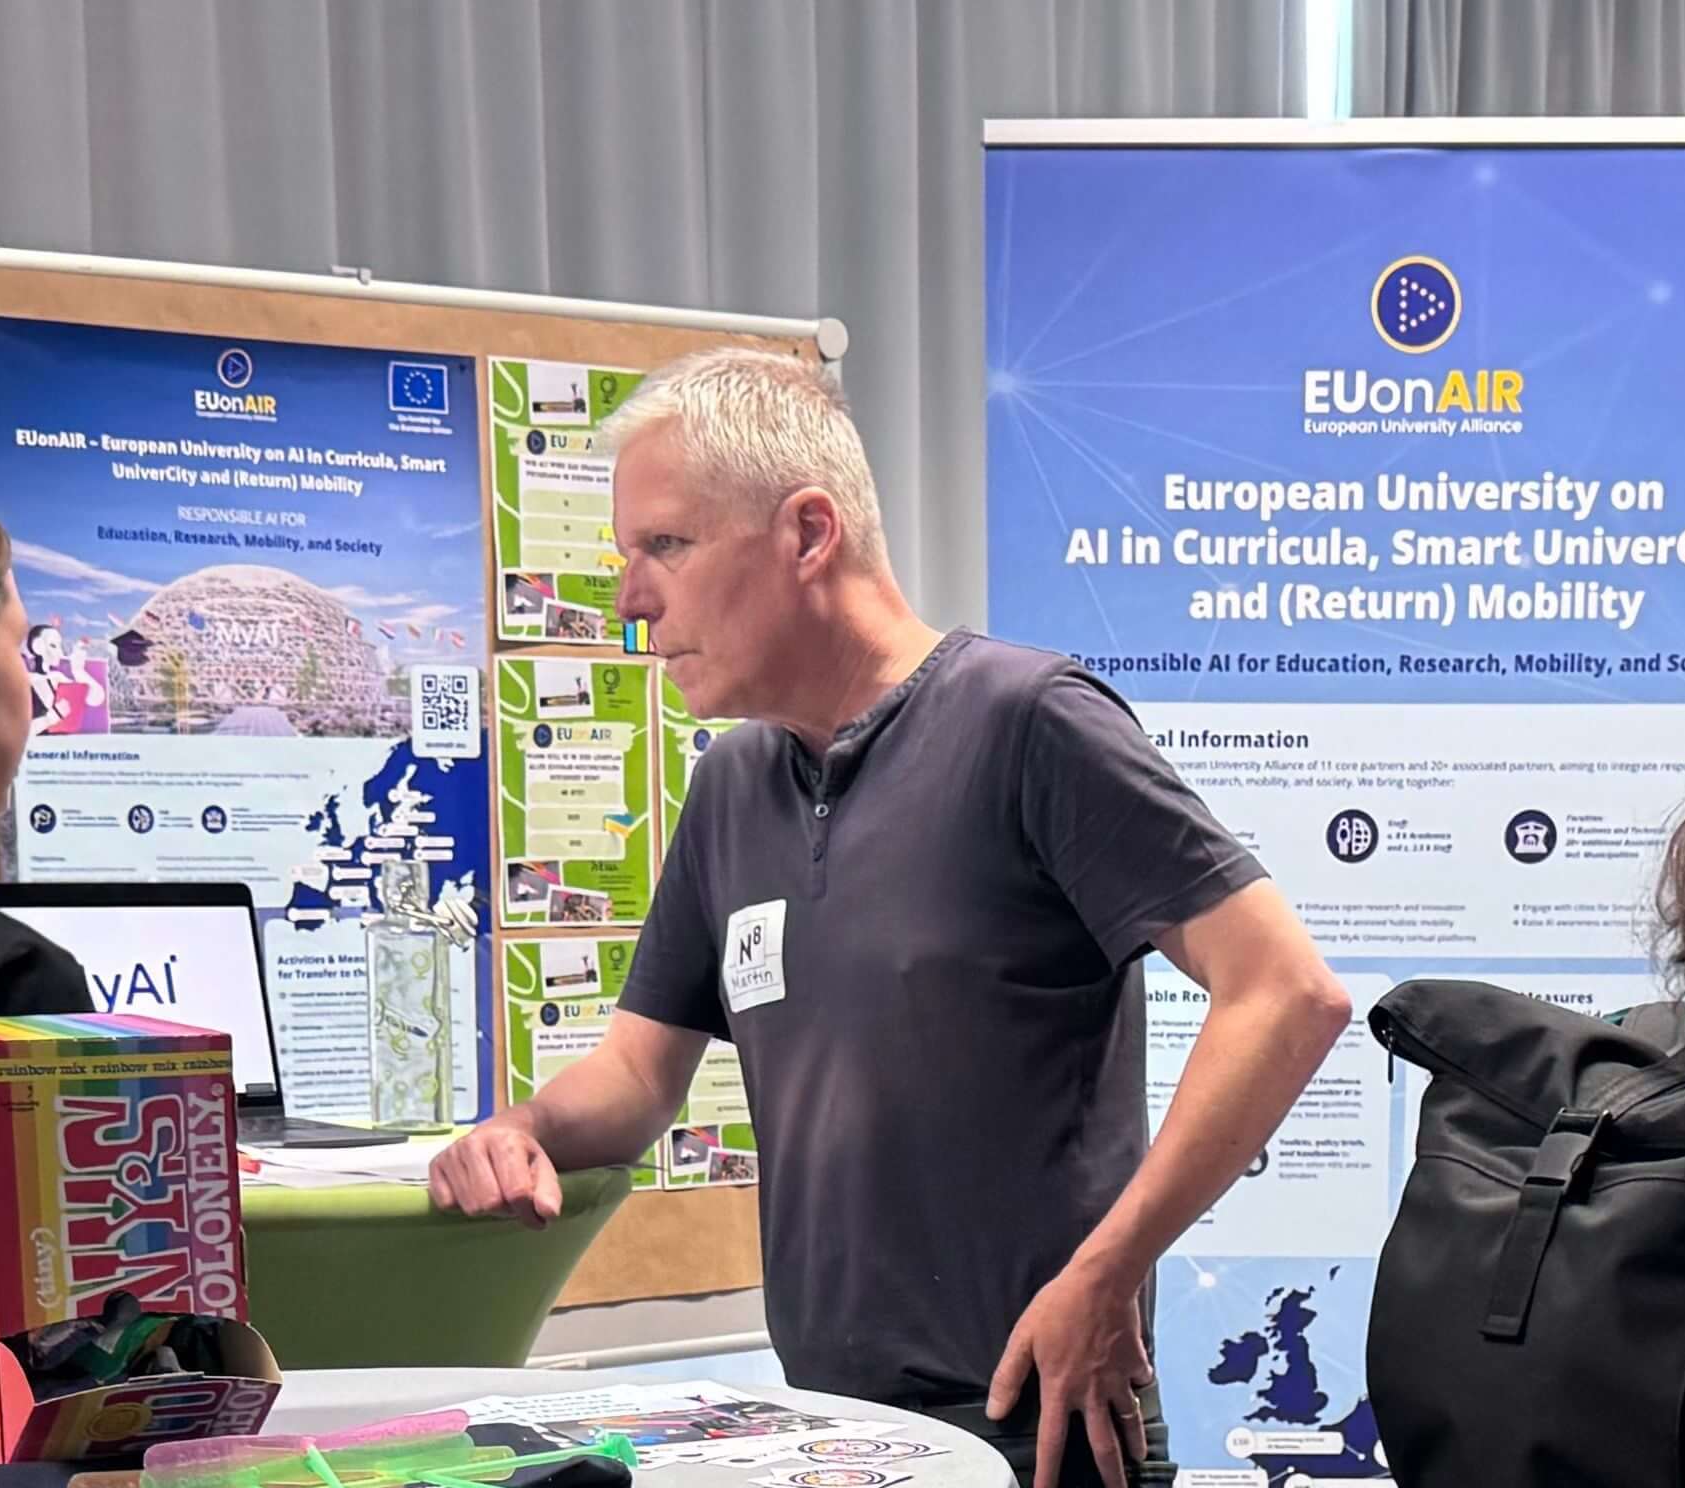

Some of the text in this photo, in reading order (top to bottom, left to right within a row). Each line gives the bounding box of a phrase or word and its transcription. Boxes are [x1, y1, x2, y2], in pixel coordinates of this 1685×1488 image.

[194, 390, 276, 414] EUonAIR
[1304, 369, 1523, 415] EUonAIR
[1304, 418, 1522, 437] European University Alliance
[16, 429, 87, 450] EUonAIR
[102, 436, 178, 458] European
[180, 440, 261, 465] University
[265, 448, 284, 460] on
[289, 447, 303, 462] AI
[308, 448, 321, 464] in
[325, 449, 398, 472] Curricula,
[401, 454, 446, 472] Smart
[113, 463, 363, 497] UniverCity and (Return) Mobility
[1164, 472, 1664, 521] European University on
[177, 506, 263, 525] RESPONSIBLE
[281, 512, 306, 527] FOR
[97, 526, 383, 556] Education, Research, Mobility, and Society
[1065, 532, 1108, 564] AI
[1122, 529, 1160, 564] in
[1174, 529, 1379, 571] Curricula,
[1392, 530, 1521, 565] Smart
[1190, 582, 1644, 629] and (Return) Mobility
[1208, 653, 1230, 672] AI
[1238, 652, 1269, 672] for
[1276, 653, 1391, 676] Education,
[1399, 653, 1507, 676] Research,
[1515, 653, 1613, 677] Mobility,
[1618, 653, 1661, 673] and
[1181, 730, 1308, 749] Information
[27, 749, 140, 762] General Information
[1210, 760, 1261, 772] University
[1264, 760, 1304, 770] Alliance
[1307, 760, 1317, 770] of
[1335, 762, 1358, 771] core
[1361, 761, 1405, 773] partners
[1408, 760, 1428, 770] and
[1452, 760, 1506, 771] associated
[1597, 762, 1608, 771] to
[1196, 776, 1242, 788] research,
[1294, 776, 1313, 787] and
[1377, 776, 1404, 789] bring
[278, 954, 365, 965] Activities & Meas
[278, 968, 366, 980] for Transfer to th
[59, 1062, 86, 1075] mix
[92, 1060, 148, 1074] rainbow
[153, 1059, 176, 1072] mix
[30, 1224, 57, 1309] (tiny)
